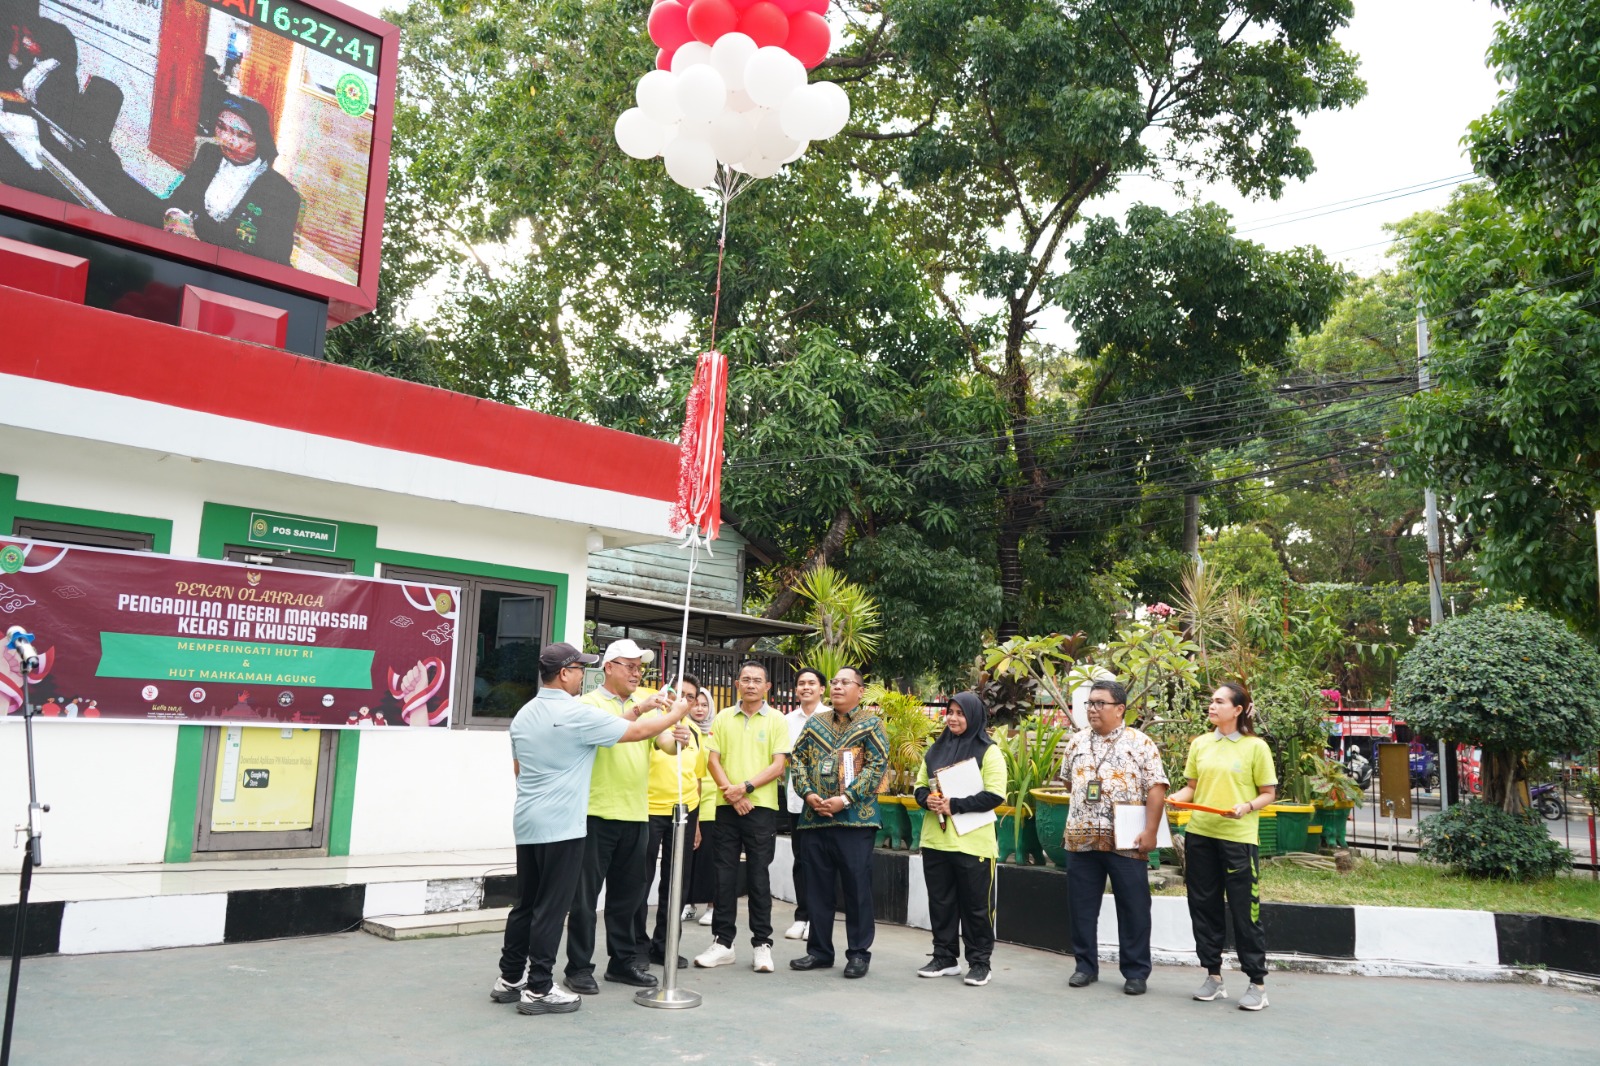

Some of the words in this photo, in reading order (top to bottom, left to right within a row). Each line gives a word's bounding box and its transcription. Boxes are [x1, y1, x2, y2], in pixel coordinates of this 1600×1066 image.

[257, 0, 375, 68] 16:27:41
[272, 526, 292, 536] POS
[293, 529, 329, 541] SATPAM
[175, 581, 235, 600] PEKAN
[238, 587, 325, 607] OLAHRAGA
[118, 593, 222, 619] PENGADILAN
[227, 603, 280, 623] NEGERI
[284, 608, 368, 630] MAKASSAR
[178, 616, 229, 637] KELAS
[233, 620, 250, 638] IA
[255, 622, 317, 643] KHUSUS
[177, 641, 271, 656] MEMPERINGATI
[275, 648, 299, 658] HUT
[302, 650, 313, 659] RI
[242, 659, 250, 668] &
[168, 668, 195, 678] HUT
[199, 670, 272, 682] MAHKAMAH
[276, 674, 317, 684] AGUNG
